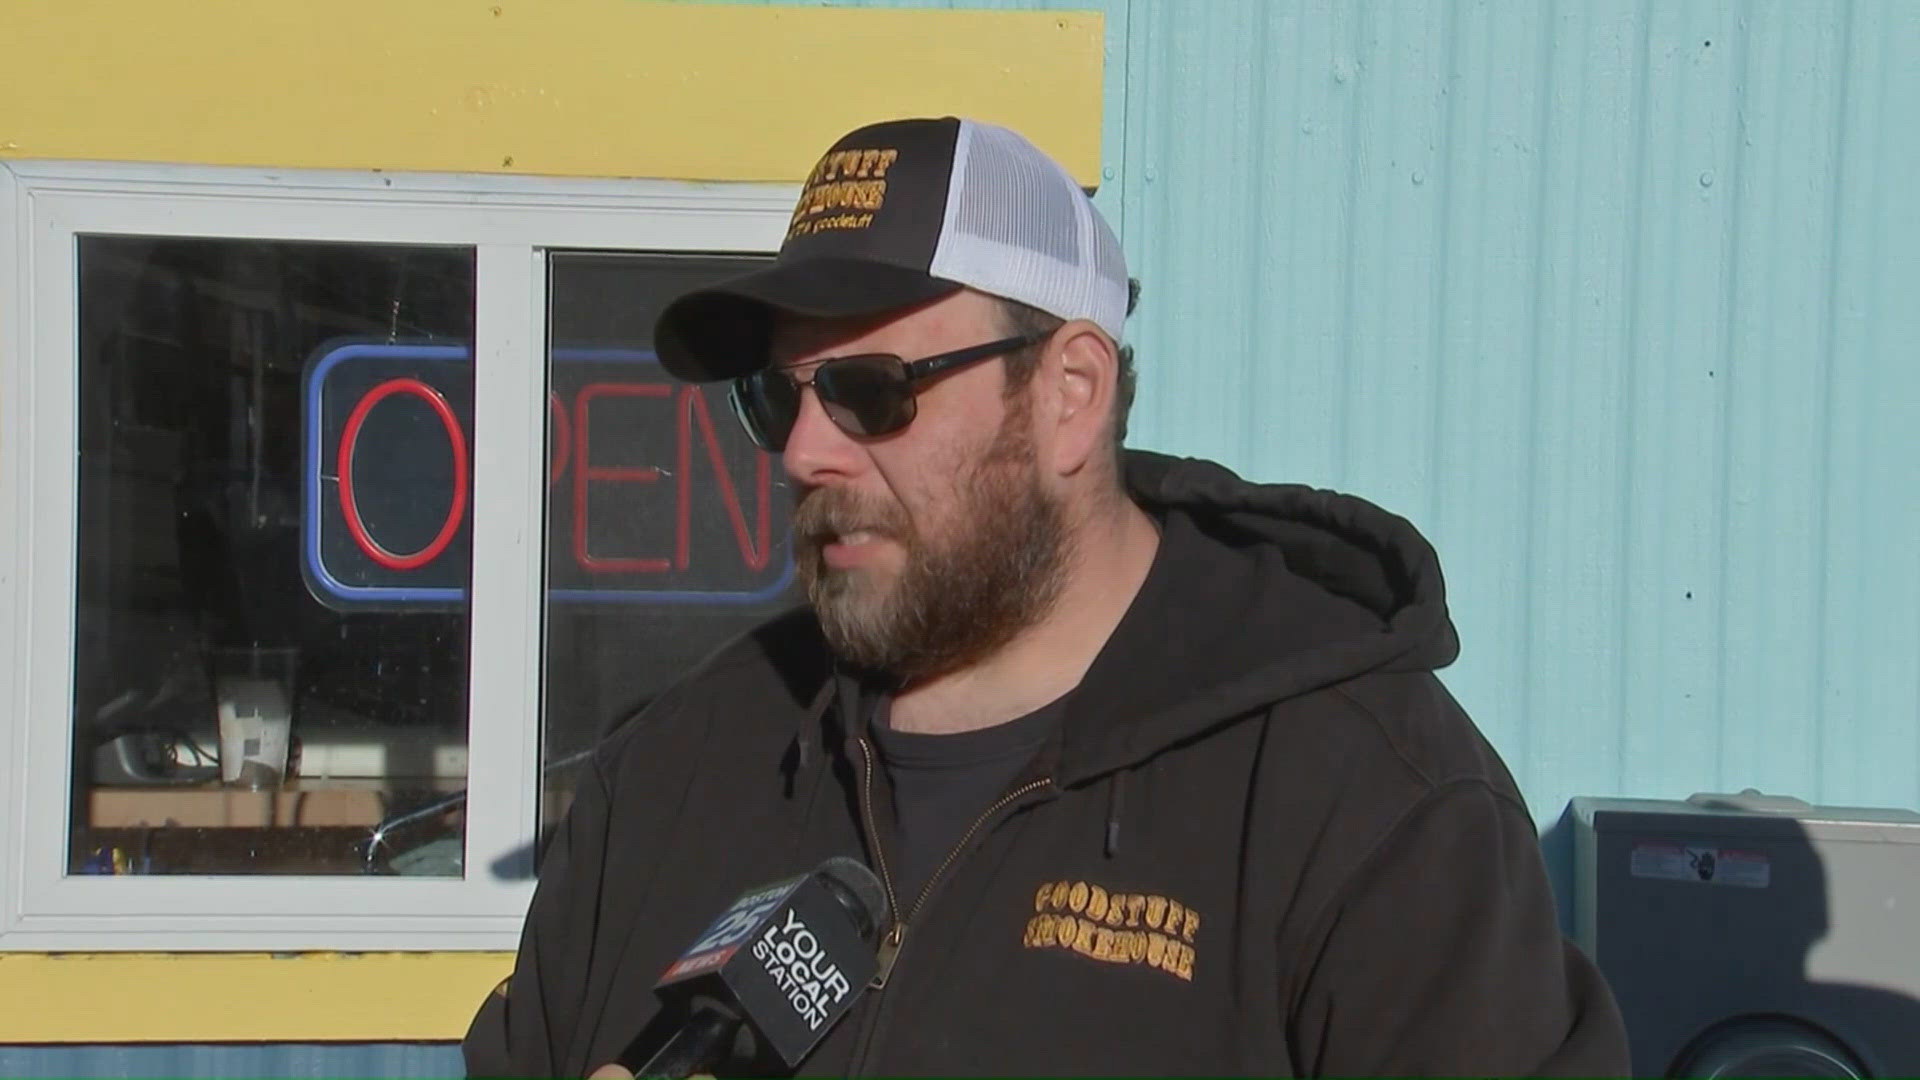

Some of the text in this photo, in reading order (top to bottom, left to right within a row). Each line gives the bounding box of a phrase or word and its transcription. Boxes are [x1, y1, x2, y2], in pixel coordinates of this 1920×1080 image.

[689, 902, 777, 955] 25
[1023, 913, 1196, 983] SMOKEHOUSE
[1035, 881, 1200, 943] GOODSTUFF
[752, 940, 824, 1032] STATION
[764, 925, 829, 1019] LOCAL
[782, 908, 851, 1004] YOUR
